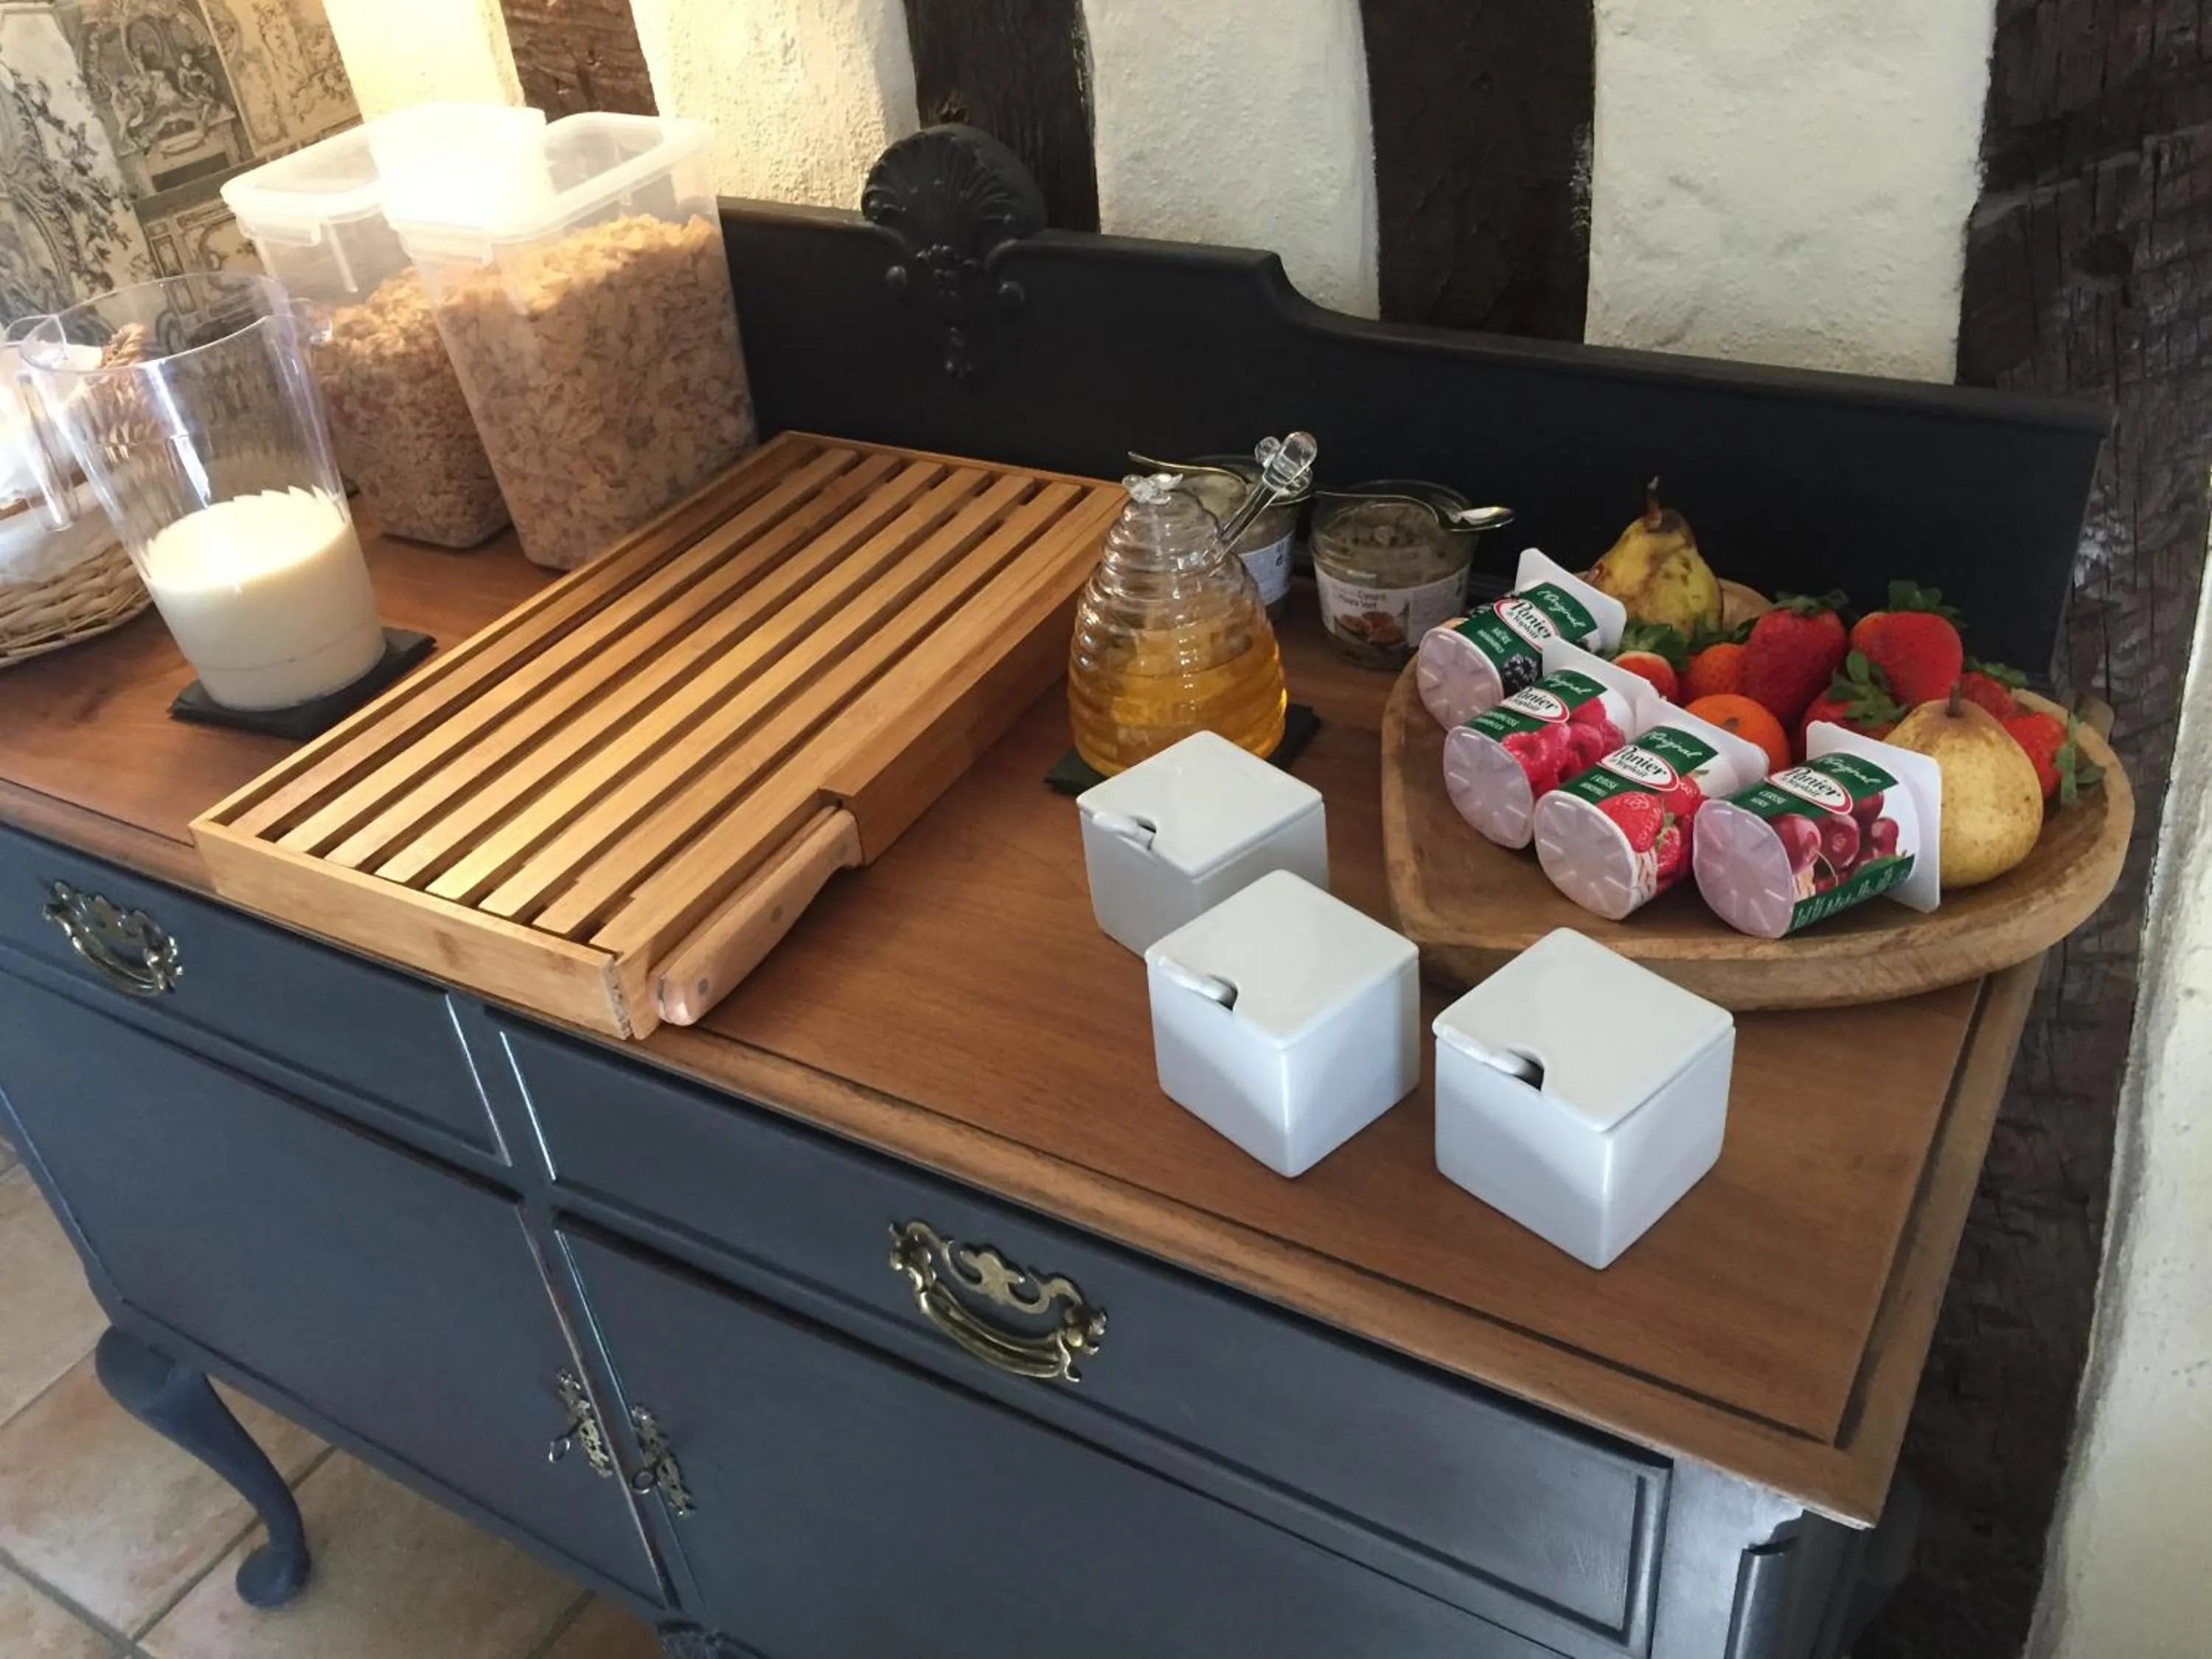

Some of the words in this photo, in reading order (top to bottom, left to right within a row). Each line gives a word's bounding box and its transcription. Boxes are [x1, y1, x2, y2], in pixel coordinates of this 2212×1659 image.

[1510, 602, 1551, 639] Panier
[1613, 747, 1668, 776] Panier
[1786, 769, 1841, 797] Panier
